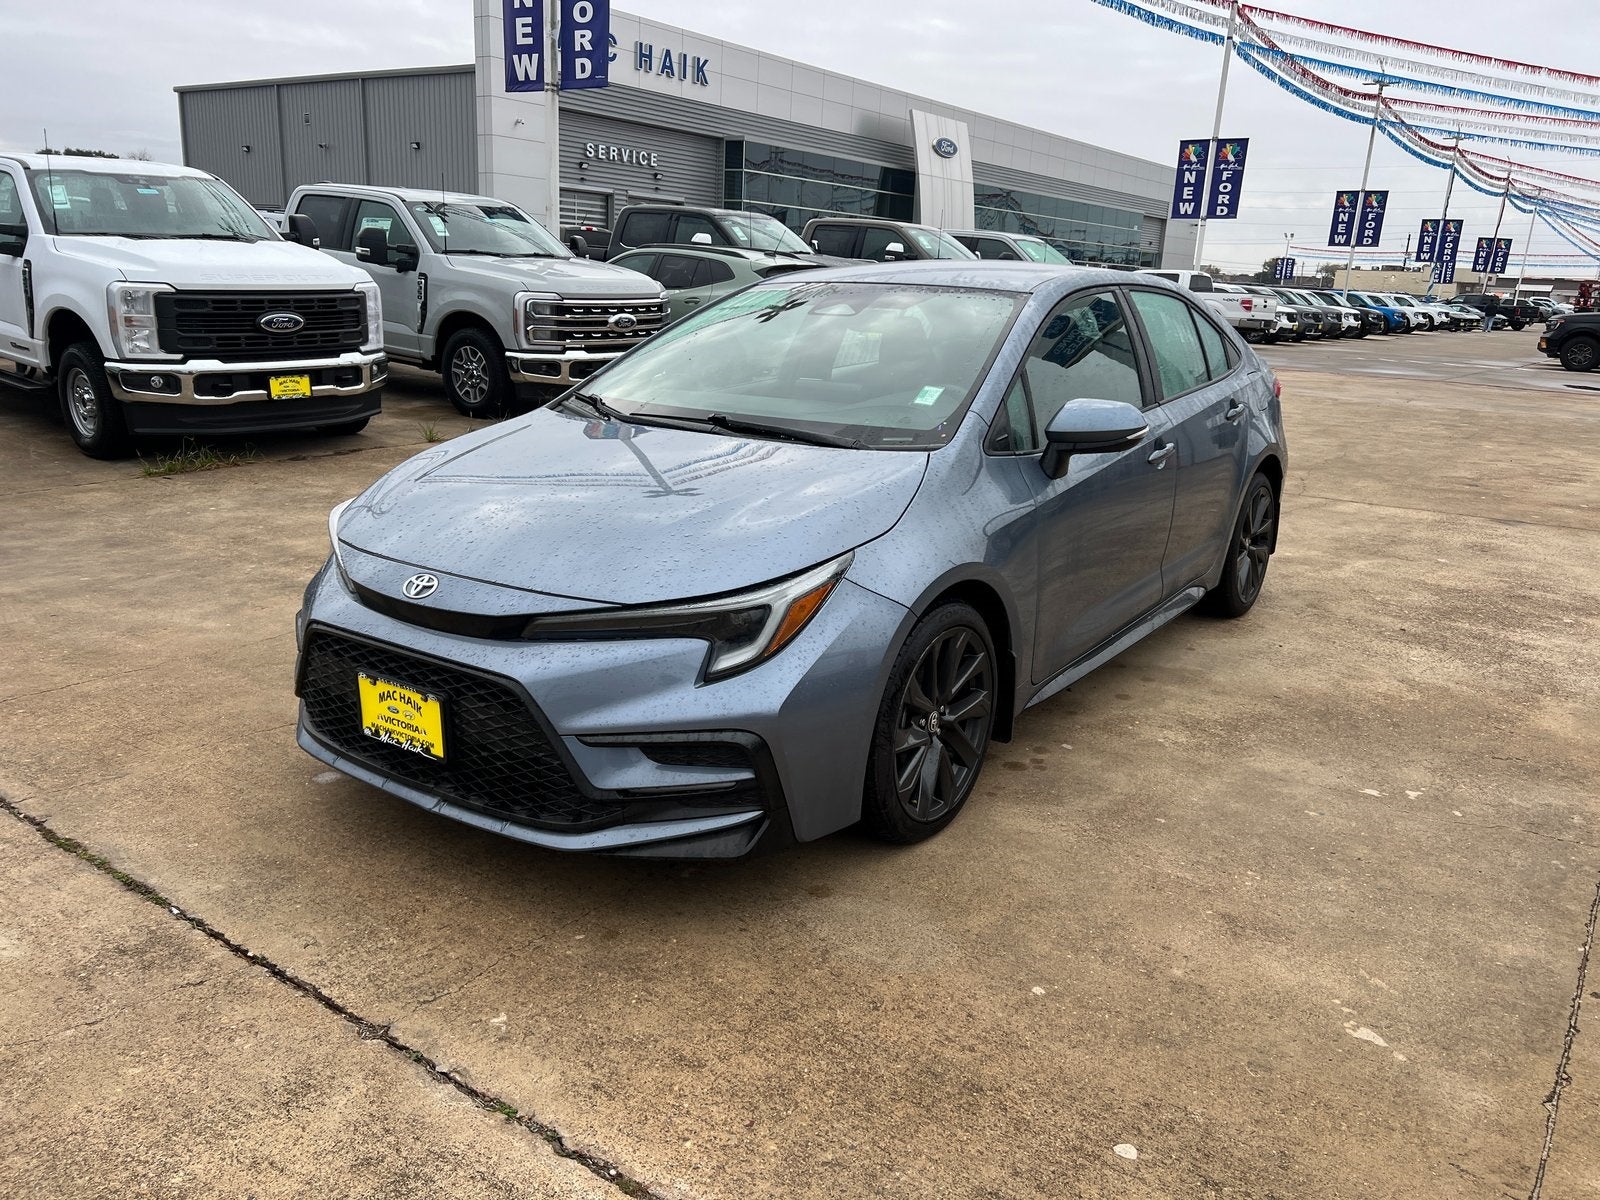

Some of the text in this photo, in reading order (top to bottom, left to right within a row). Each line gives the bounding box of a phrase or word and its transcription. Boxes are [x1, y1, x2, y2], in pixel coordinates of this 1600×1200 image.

[572, 0, 594, 80] ORD
[634, 40, 710, 86] HAIK
[585, 142, 659, 168] SERVICE
[1179, 171, 1197, 215] NEW
[1215, 171, 1233, 216] FORD
[1334, 212, 1349, 244] NEW
[1362, 213, 1377, 245] FORD
[1420, 236, 1432, 260] NEW
[1442, 236, 1454, 261] FORD
[1475, 251, 1487, 271] NEW
[1494, 251, 1504, 272] FORD
[271, 317, 295, 329] Ford
[378, 690, 423, 718] MAC HAIK
[382, 714, 421, 735] VICTORIA
[379, 732, 401, 747] Mac
